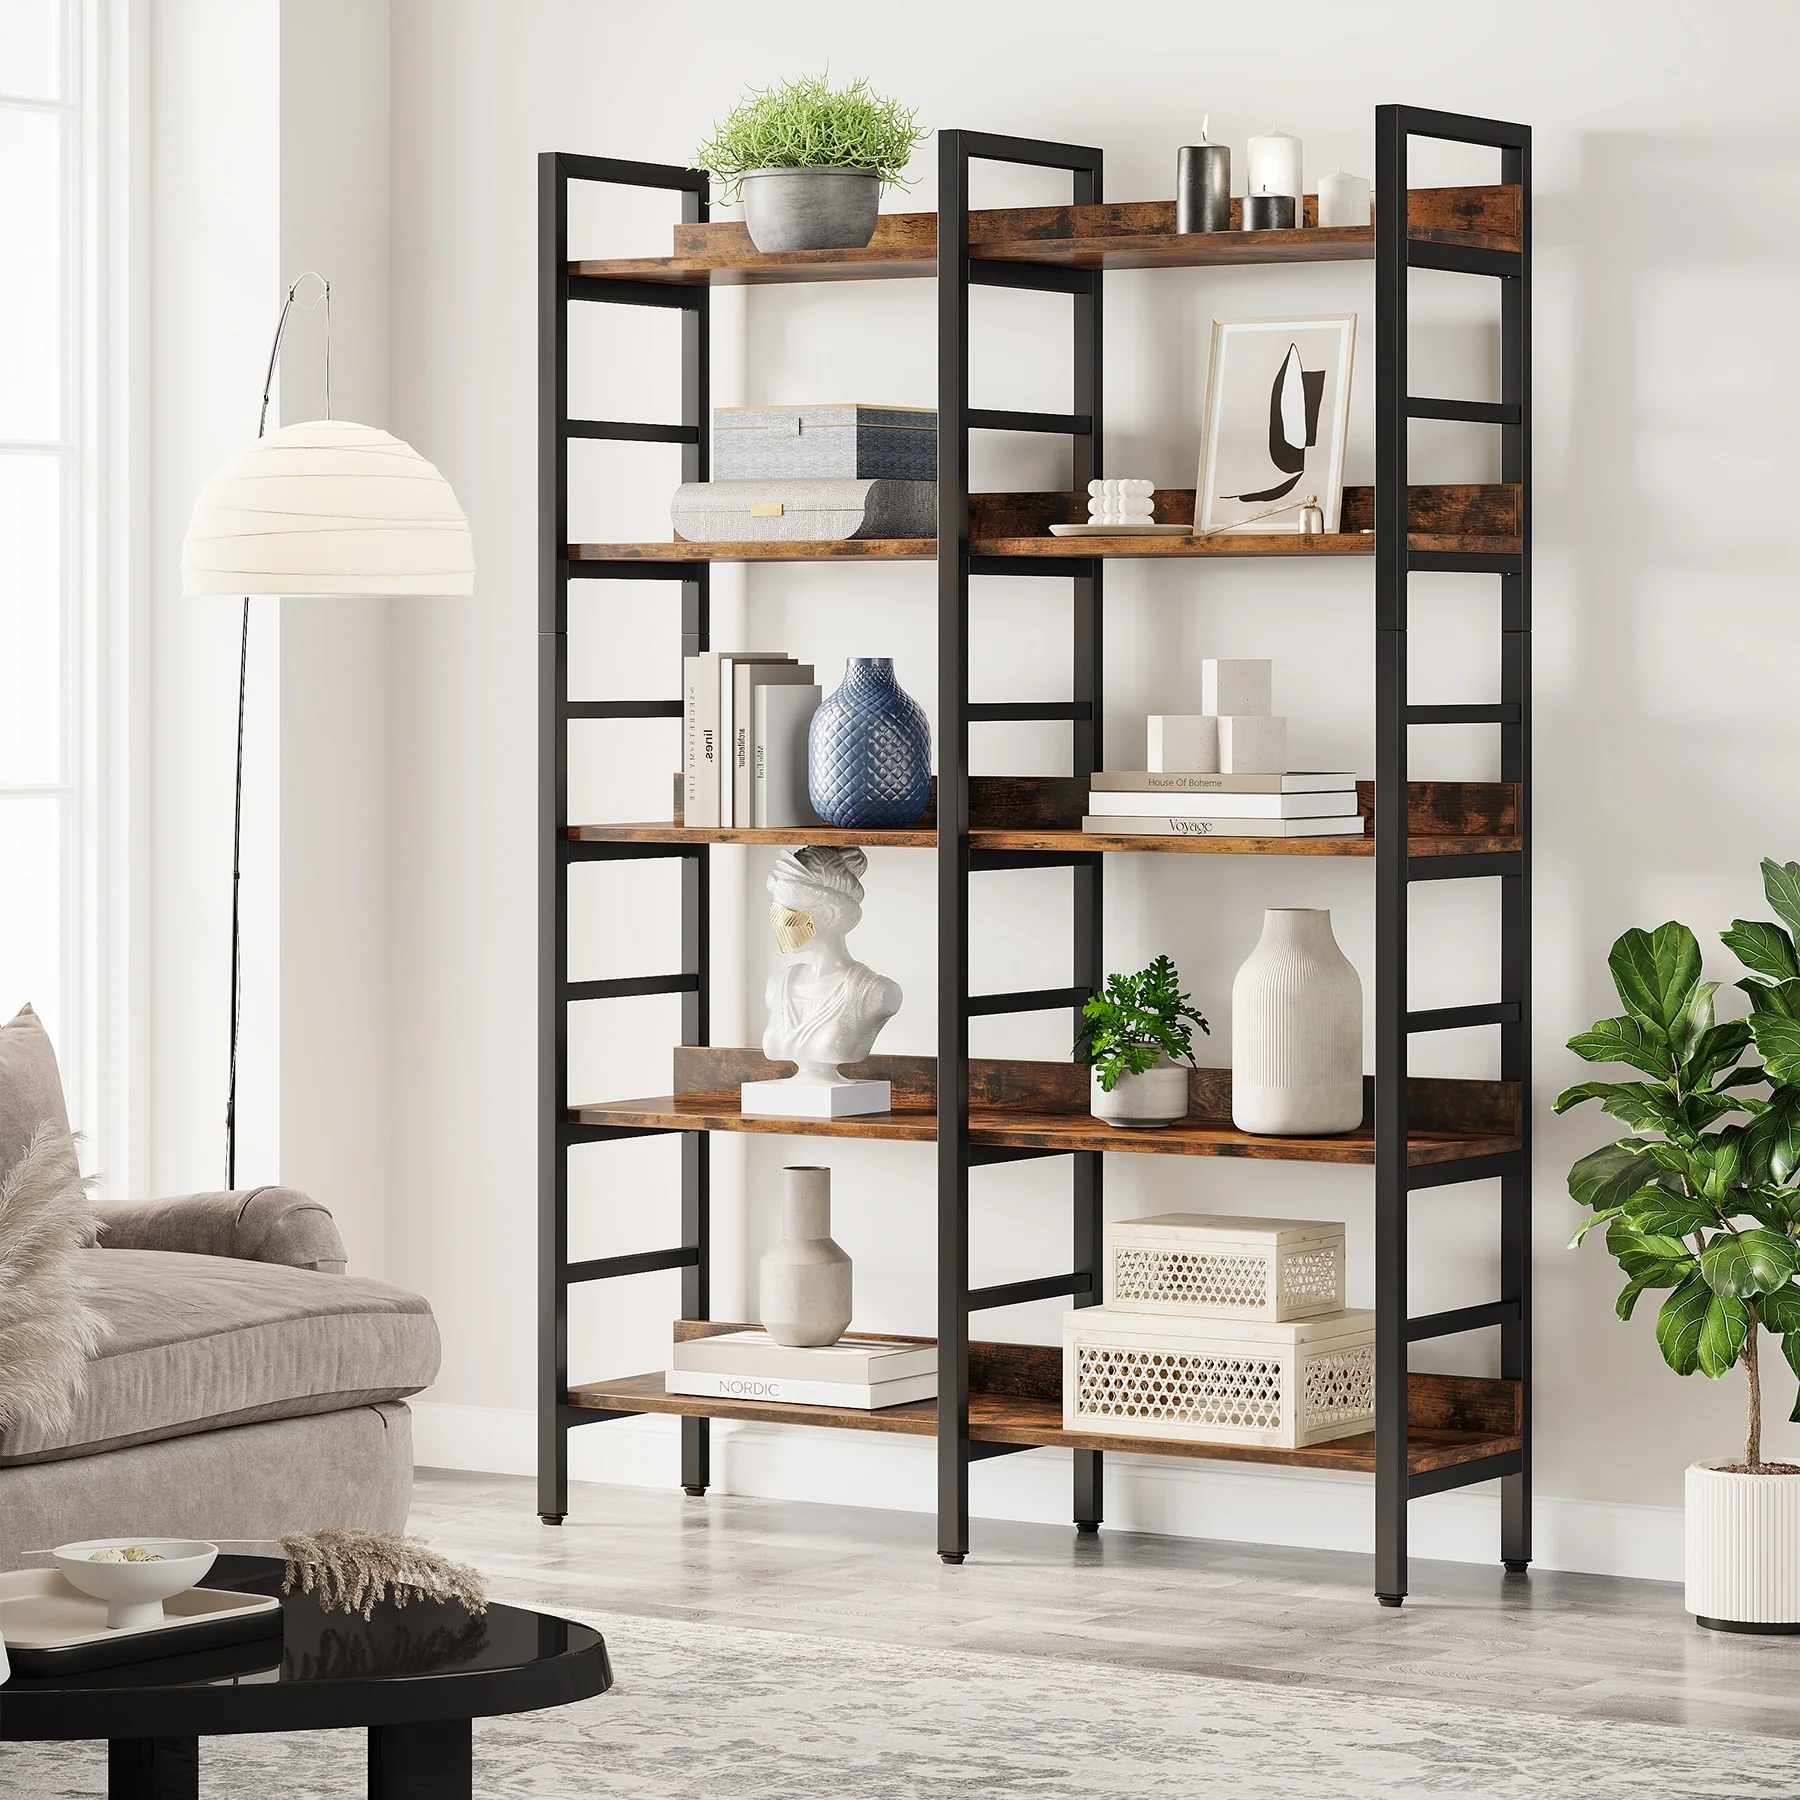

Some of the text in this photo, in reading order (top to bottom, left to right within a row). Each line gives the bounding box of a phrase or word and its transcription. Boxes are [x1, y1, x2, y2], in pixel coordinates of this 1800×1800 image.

[1148, 778, 1223, 787] House Of Boheme
[1169, 819, 1213, 834] Voyage
[719, 1380, 780, 1397] NORDIC
